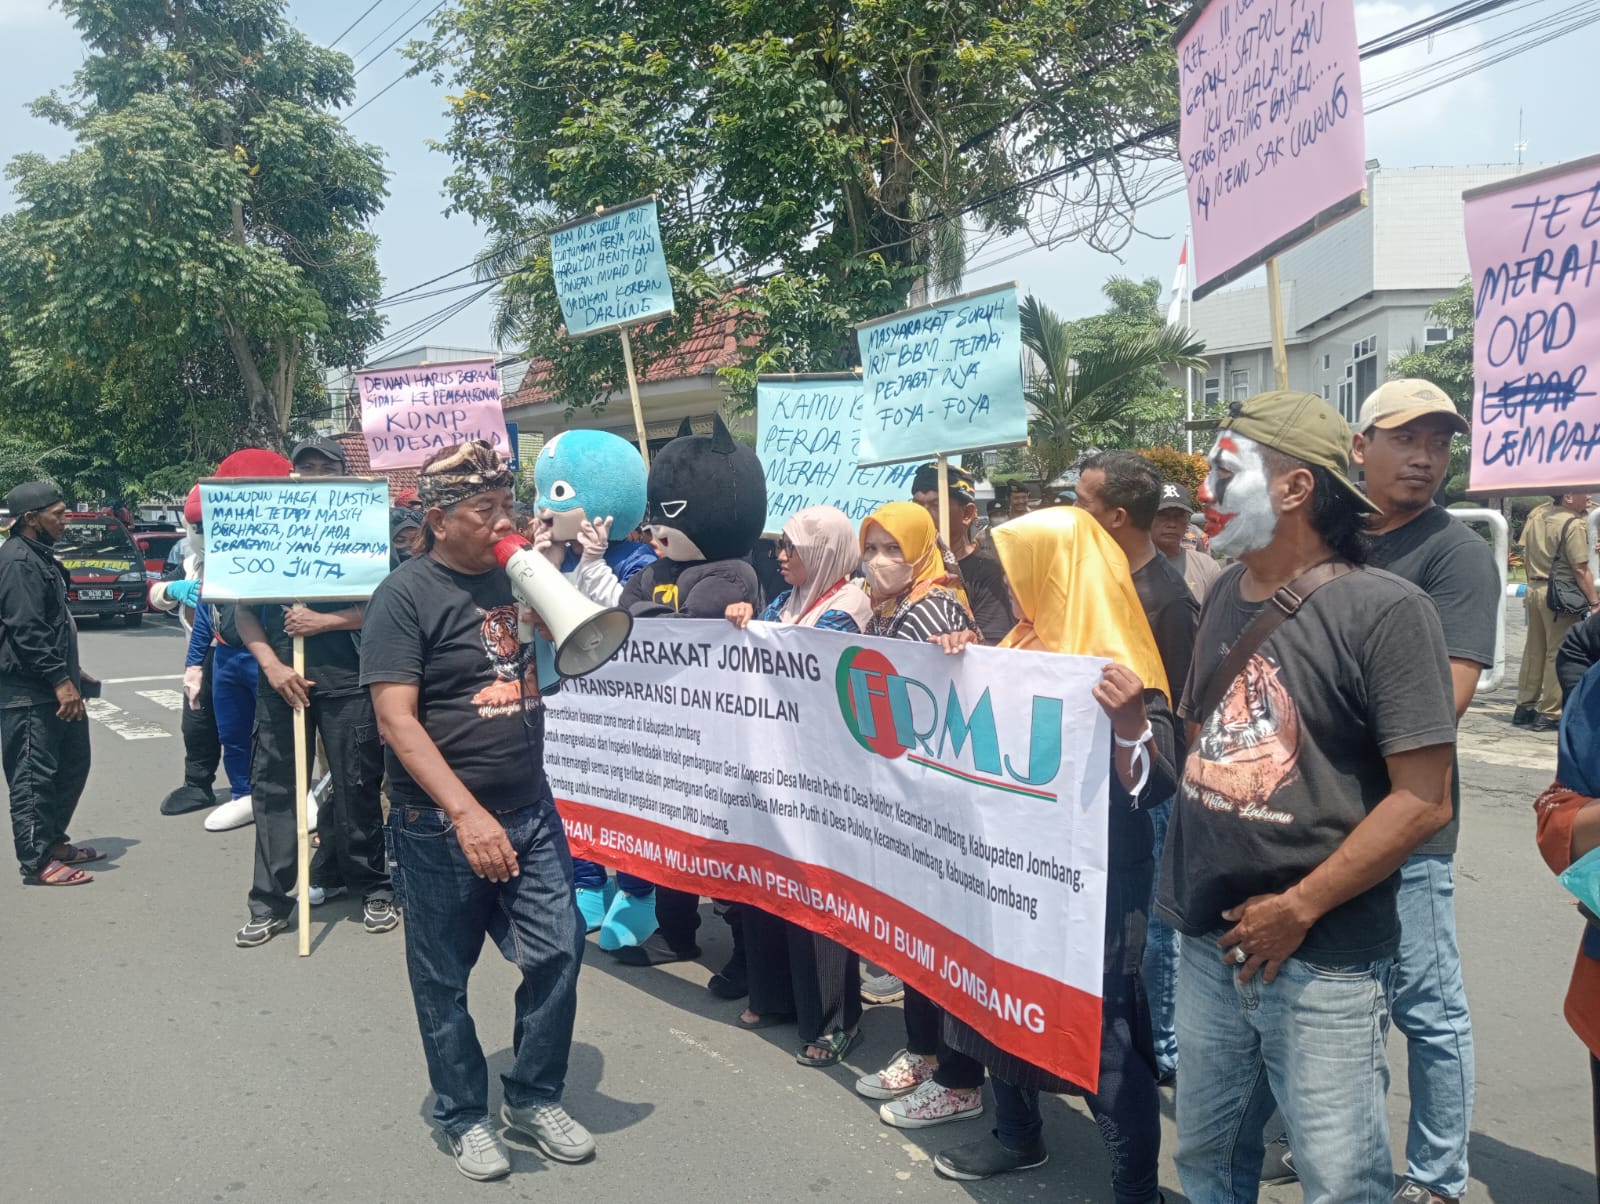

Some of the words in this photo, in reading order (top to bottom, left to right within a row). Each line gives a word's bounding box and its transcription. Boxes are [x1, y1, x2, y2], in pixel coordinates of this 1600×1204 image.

[1189, 143, 1216, 182] SENG
[1218, 100, 1267, 168] PENTING
[1256, 137, 1285, 176] SAK
[616, 280, 661, 299] KORBAN
[585, 298, 653, 327] DARLING
[868, 310, 955, 353] MASYARAKAT
[1488, 302, 1576, 367] OPD
[364, 374, 410, 393] DEWAN
[413, 372, 454, 388] HARUS
[874, 368, 939, 405] PEJABAT
[386, 410, 467, 432] KDMP
[772, 392, 844, 421] KAMU
[942, 394, 990, 424] FOYA
[372, 435, 389, 453] DI
[394, 433, 445, 451] DESA
[763, 424, 842, 456] PERDA
[765, 458, 842, 488] MERAH
[208, 491, 273, 508] WALAUPUN
[278, 490, 317, 505] HARGA
[329, 492, 385, 510] PLASTIK
[211, 506, 263, 521] MAHAL
[265, 507, 311, 522] TETAPI
[315, 509, 363, 523] MASIH
[285, 540, 321, 554] YANG
[228, 557, 275, 574] 500
[717, 644, 822, 682] JOMBANG
[573, 678, 678, 705] TRANSPARANSI
[681, 689, 712, 710] DAN
[715, 691, 800, 723] KEADILAN
[579, 708, 602, 727] kawasan
[603, 714, 616, 728] zona
[617, 714, 635, 730] merah
[636, 716, 643, 731] di
[643, 718, 675, 739] Kabupaten
[675, 723, 701, 746] Jombang
[848, 667, 1064, 785] FRMJ
[550, 776, 574, 793] Jombang
[575, 780, 591, 795] untuk
[591, 783, 628, 806] membatalkan
[629, 794, 658, 812] pengadaan
[658, 801, 682, 820] seragam
[682, 805, 699, 824] DPRD
[560, 730, 596, 751] mengevaluasi
[597, 738, 608, 751] dan
[608, 736, 632, 758] Inspeksi
[632, 743, 662, 761] Mendadak
[663, 748, 682, 765] terkait
[682, 752, 723, 778] pembangunan
[724, 759, 740, 779] Gerai
[741, 764, 775, 785] Koperasi
[777, 769, 797, 788] Desa
[799, 773, 822, 794] Merah
[823, 779, 842, 800] Putih
[843, 784, 850, 800] di
[852, 787, 868, 808] Desa
[895, 802, 932, 836] Kecamatan
[934, 818, 968, 855] Jombang,
[969, 834, 1024, 870] Kabupaten
[1026, 851, 1084, 893] Jombang.
[561, 753, 591, 775] memanggil
[592, 760, 609, 774] semua
[610, 765, 623, 781] yang
[624, 766, 644, 782] terlibat
[648, 772, 662, 786] dalam
[663, 773, 703, 800] pembangunan
[704, 781, 719, 801] Gerai
[719, 787, 751, 808] Koperasi
[752, 793, 768, 813] Desa
[769, 798, 798, 818] Merah
[800, 803, 820, 823] Putih
[822, 809, 828, 825] di
[830, 810, 847, 832] Desa
[874, 827, 911, 859] Kecamatan
[946, 858, 985, 897] Kabupaten
[987, 879, 1038, 920] Jombang
[599, 826, 664, 865] BERSAMA
[664, 846, 764, 888] WUJUDKAN
[765, 872, 870, 933] PERUBAHAN
[873, 916, 890, 944] DI
[894, 926, 935, 972] BUMI
[939, 956, 1046, 1034] JOMBANG
